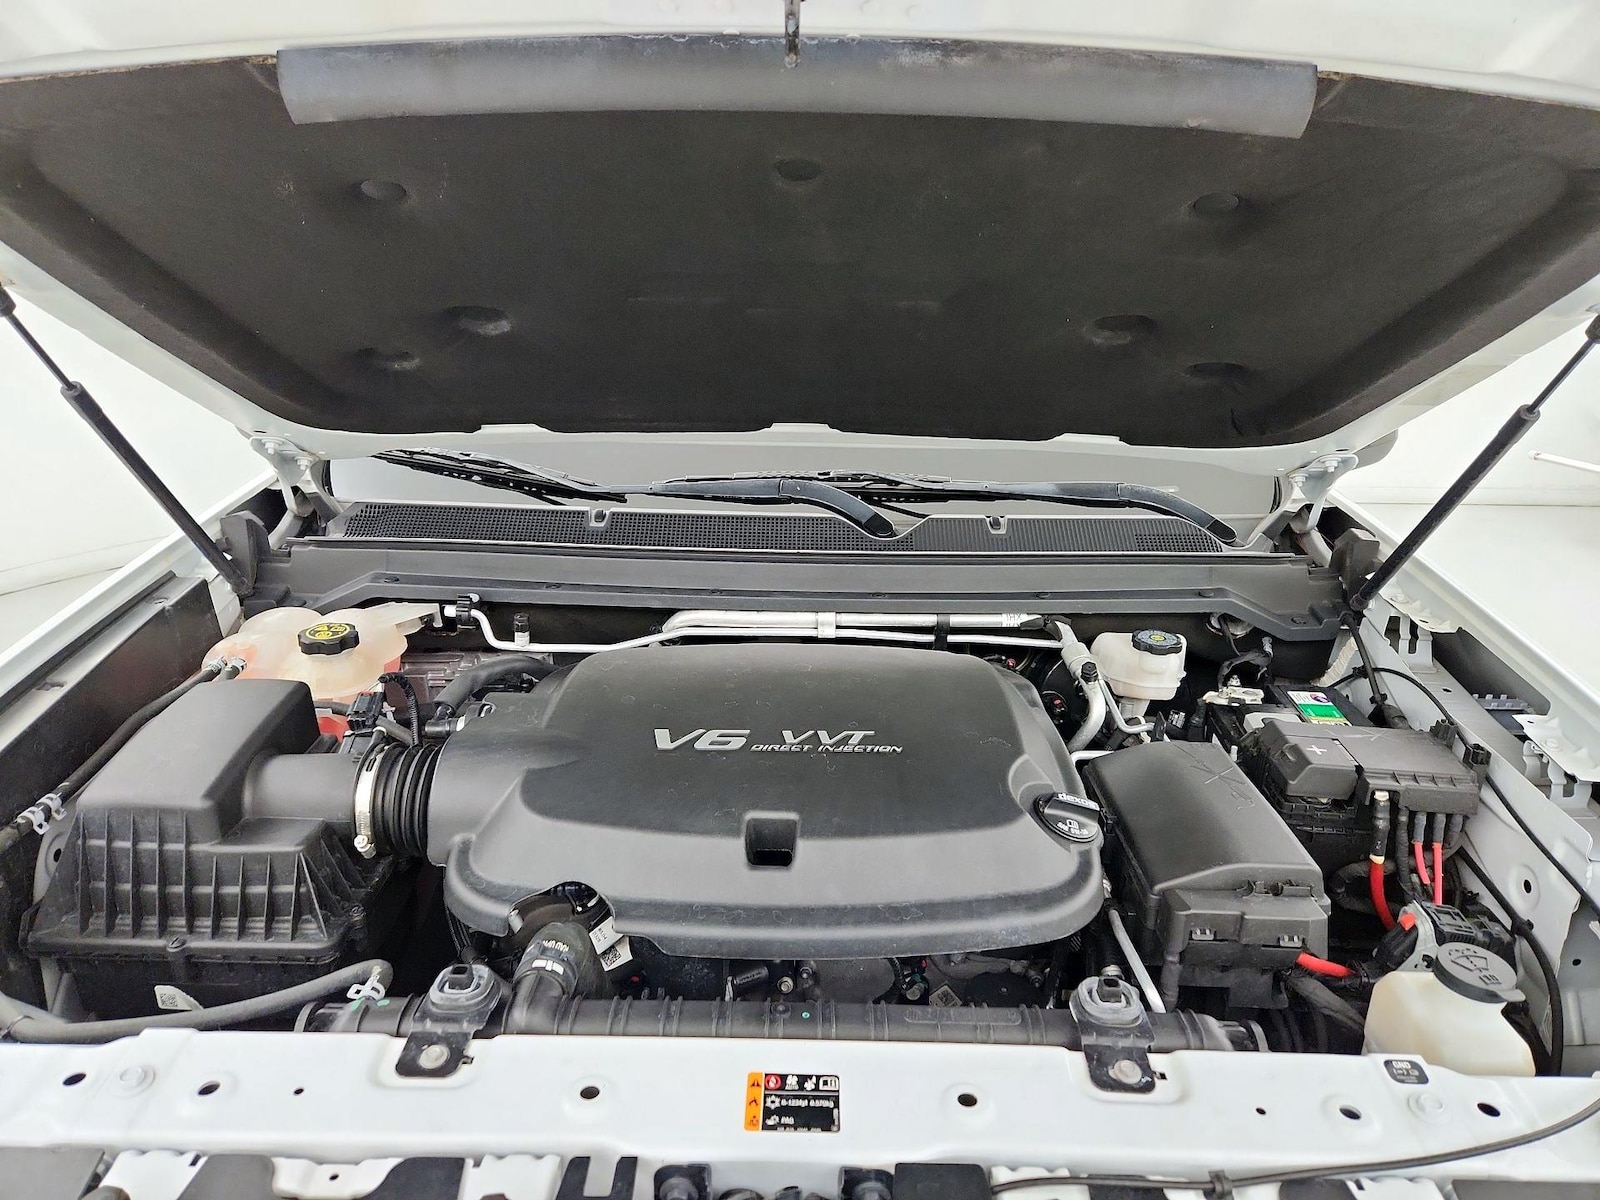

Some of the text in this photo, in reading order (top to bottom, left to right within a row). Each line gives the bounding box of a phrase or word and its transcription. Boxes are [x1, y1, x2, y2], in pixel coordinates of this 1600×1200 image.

[653, 728, 876, 751] V6 VVT
[750, 744, 903, 754] DIRECT INJECTION
